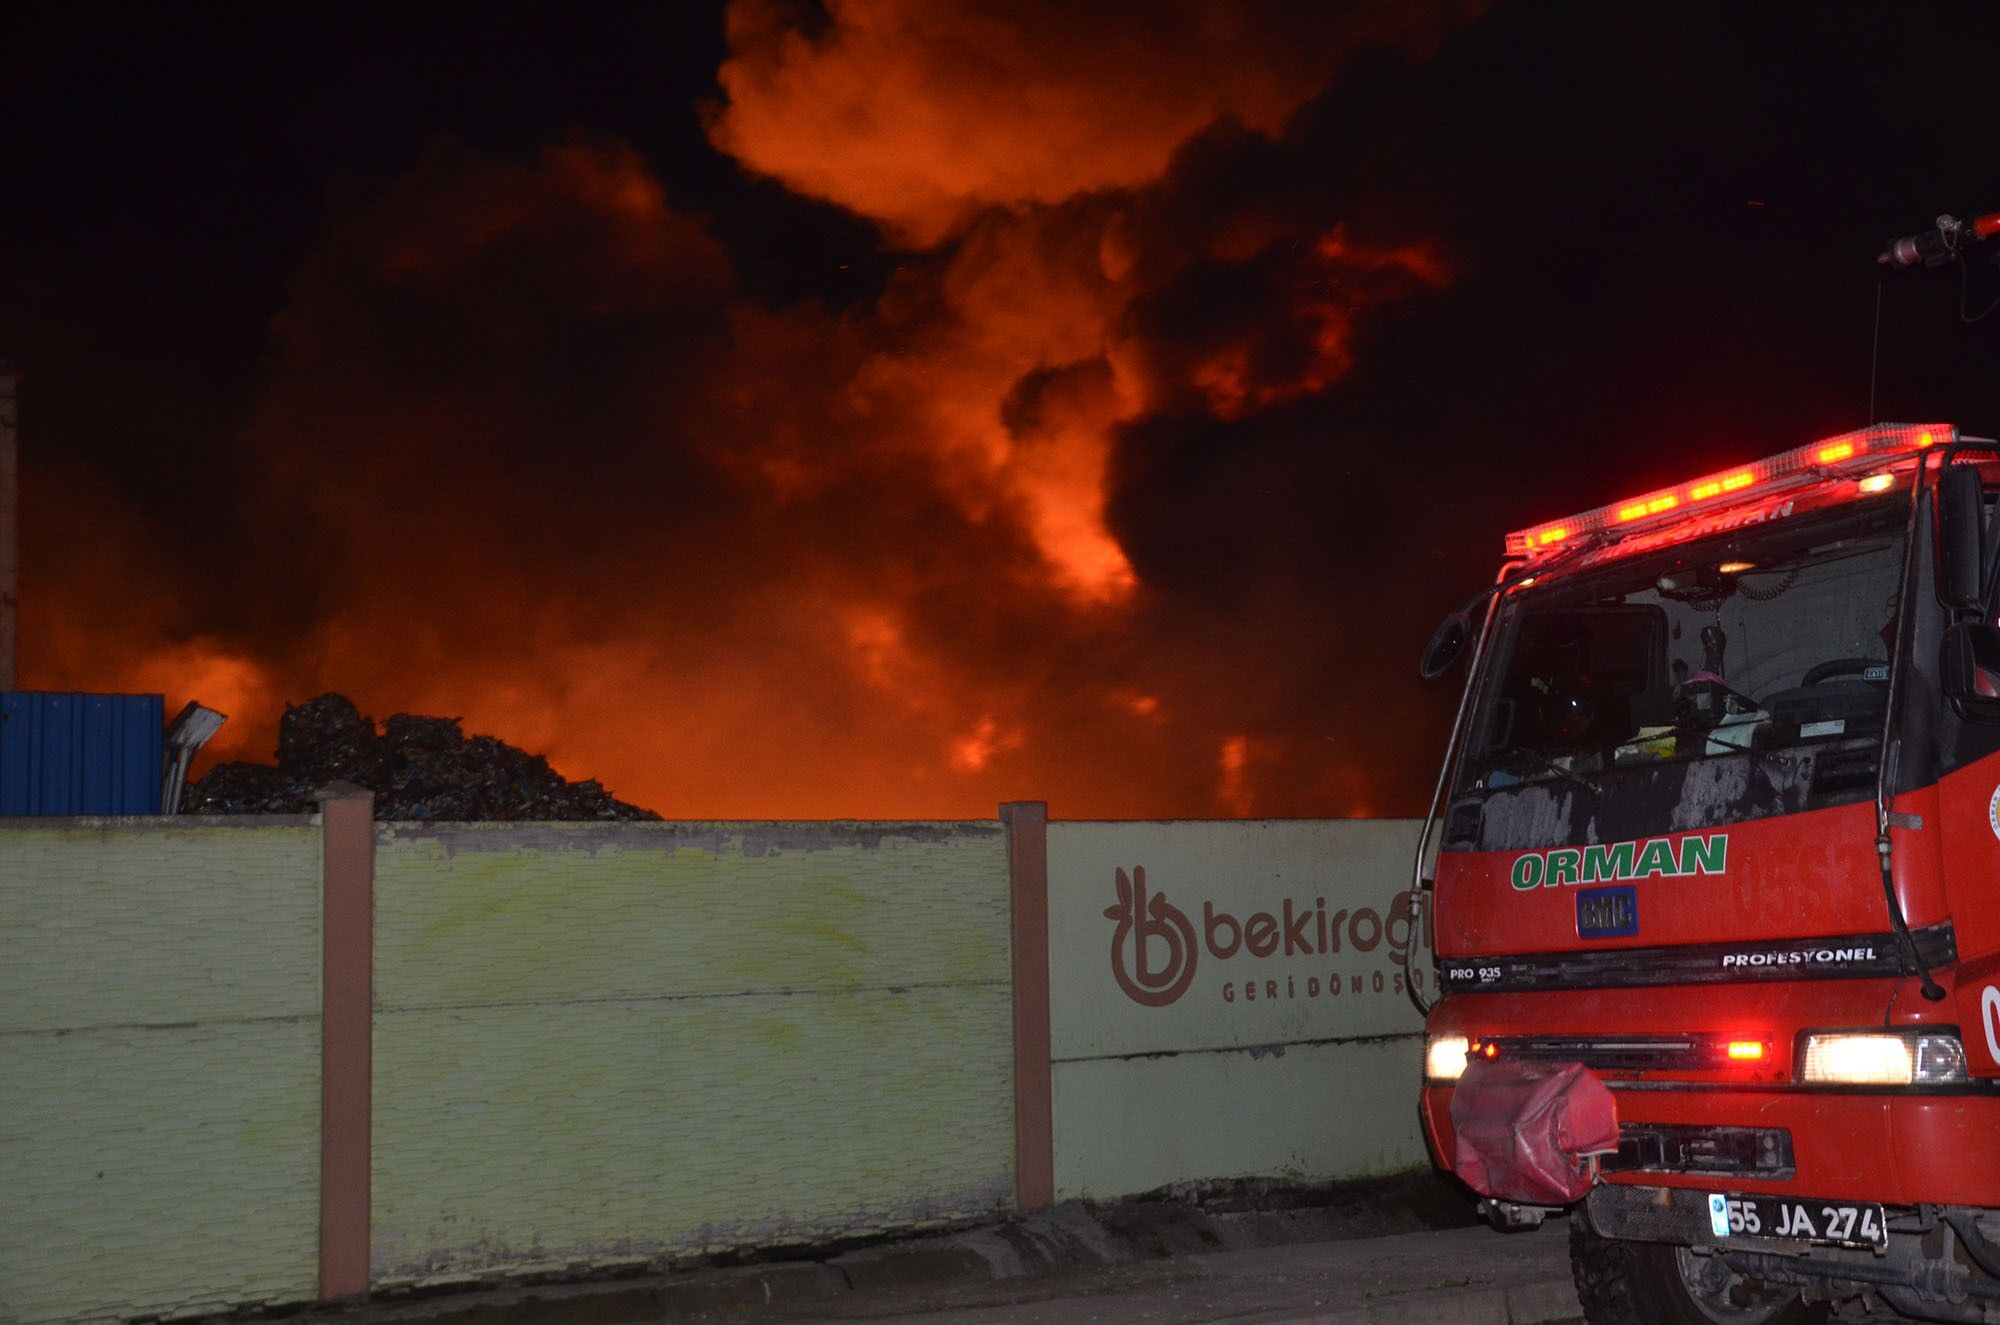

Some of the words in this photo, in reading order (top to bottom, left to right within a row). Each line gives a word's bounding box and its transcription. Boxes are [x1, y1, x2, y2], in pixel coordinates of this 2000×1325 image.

[1510, 833, 1729, 892] ORMAN
[1582, 895, 1633, 930] BMC
[1450, 968, 1474, 980] PRO
[1478, 966, 1501, 979] 935
[1722, 947, 1877, 968] PROFESYONEL
[1726, 1200, 1761, 1234] 55
[1775, 1203, 1817, 1236] JA
[1822, 1207, 1880, 1241] 274
